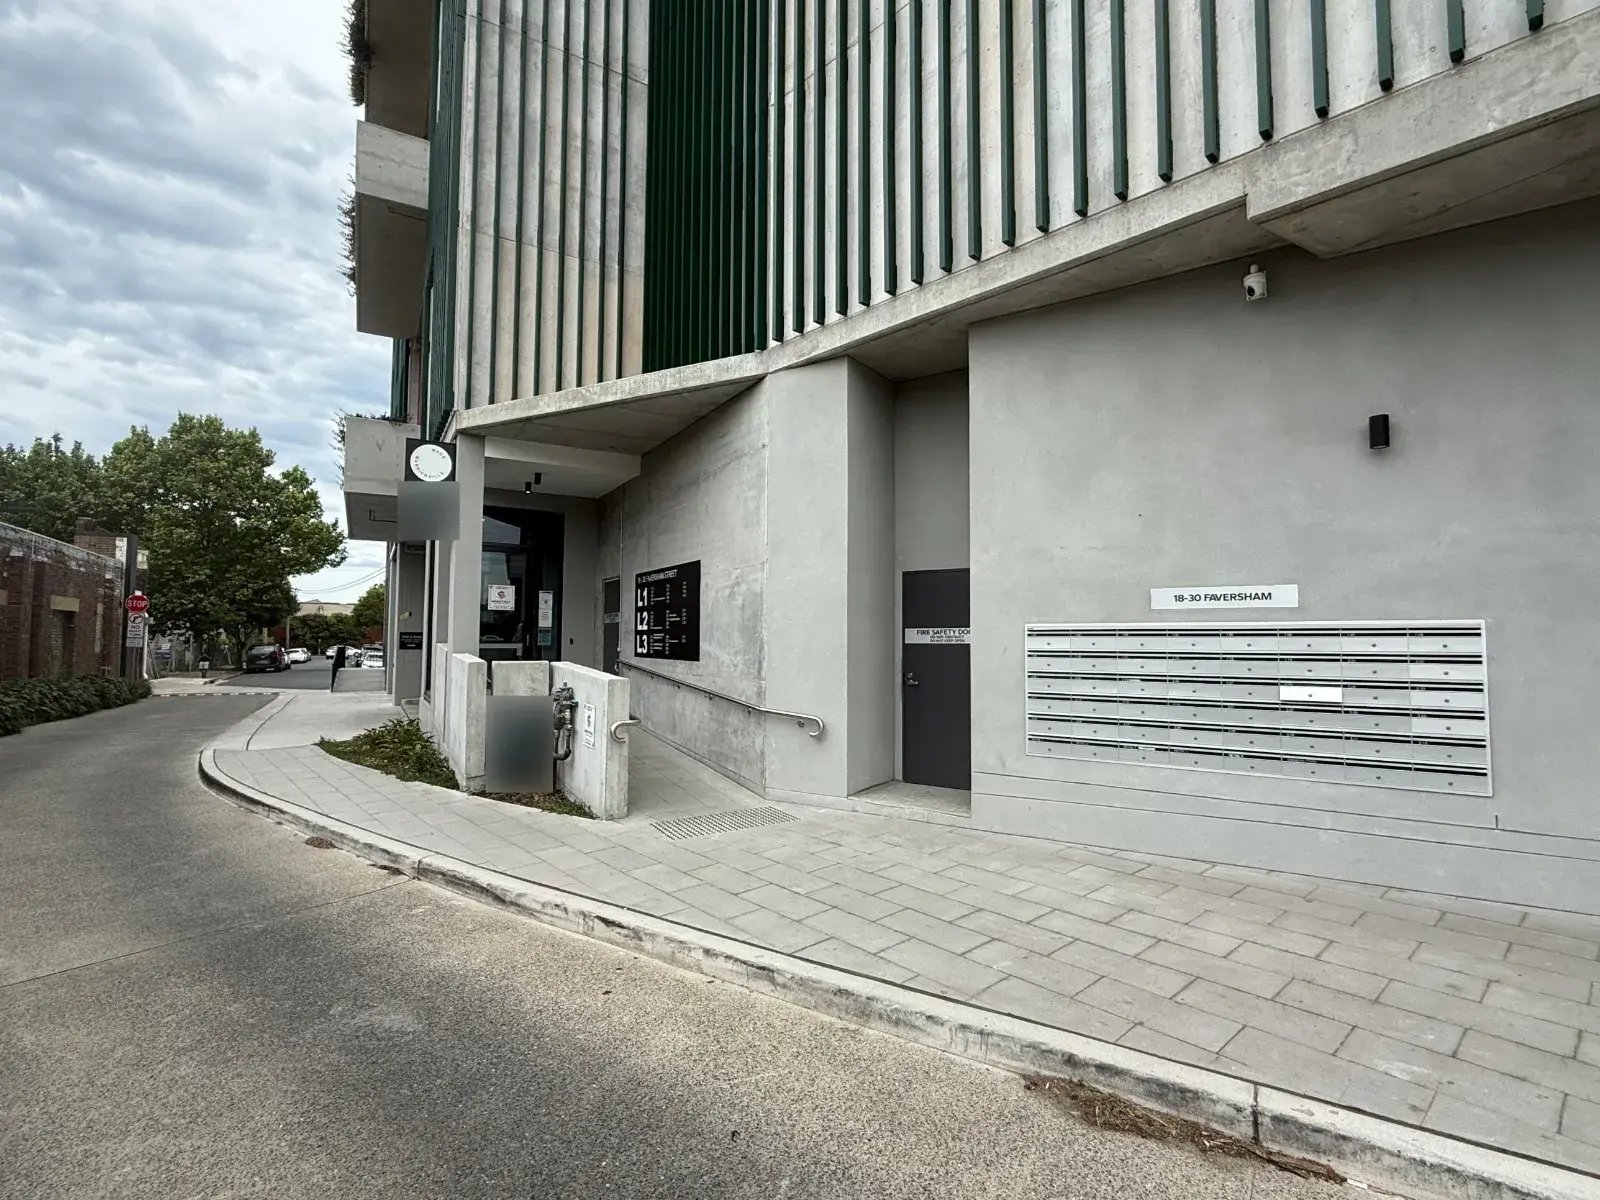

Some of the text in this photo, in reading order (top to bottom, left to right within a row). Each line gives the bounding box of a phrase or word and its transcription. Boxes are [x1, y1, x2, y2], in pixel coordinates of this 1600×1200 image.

[127, 600, 148, 608] STOP
[637, 587, 648, 607] L1
[1173, 592, 1272, 602] 18-30 FAVERSHAM
[637, 611, 648, 630] L2
[637, 634, 648, 653] L3
